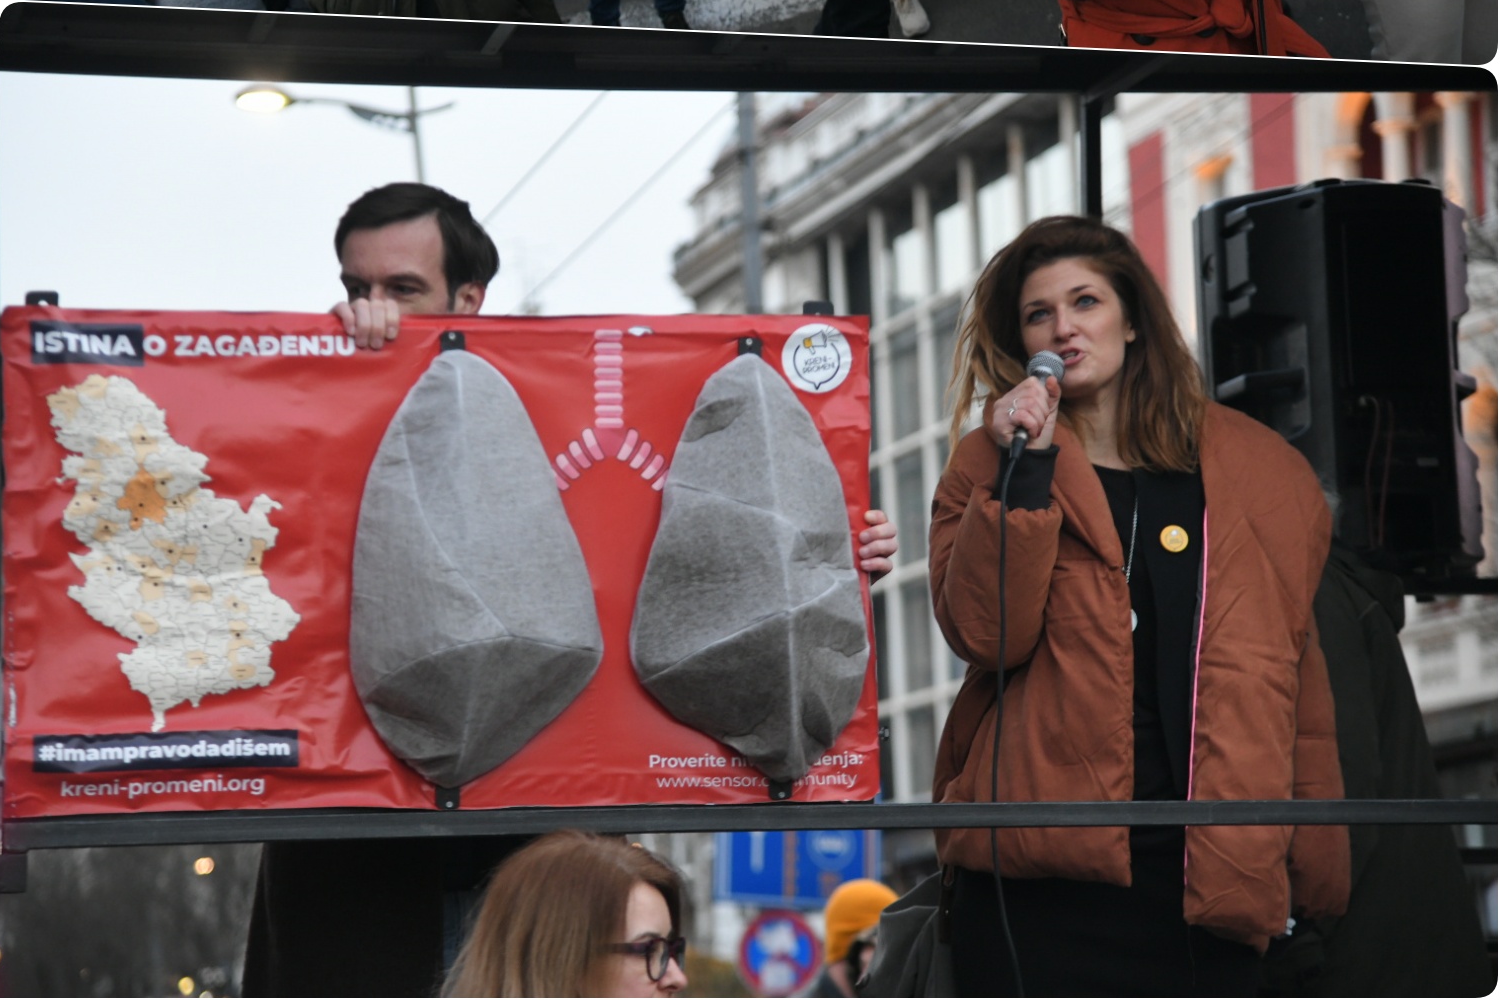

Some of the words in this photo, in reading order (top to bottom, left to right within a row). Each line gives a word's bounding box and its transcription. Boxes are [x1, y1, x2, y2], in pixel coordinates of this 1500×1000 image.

[34, 331, 137, 357] ISTINA
[142, 334, 167, 357] O
[173, 333, 356, 357] ZAGAĐENJU
[38, 738, 291, 764] #imampravodadišem
[649, 753, 726, 769] Proverite
[60, 774, 266, 800] kreni-promeni.org
